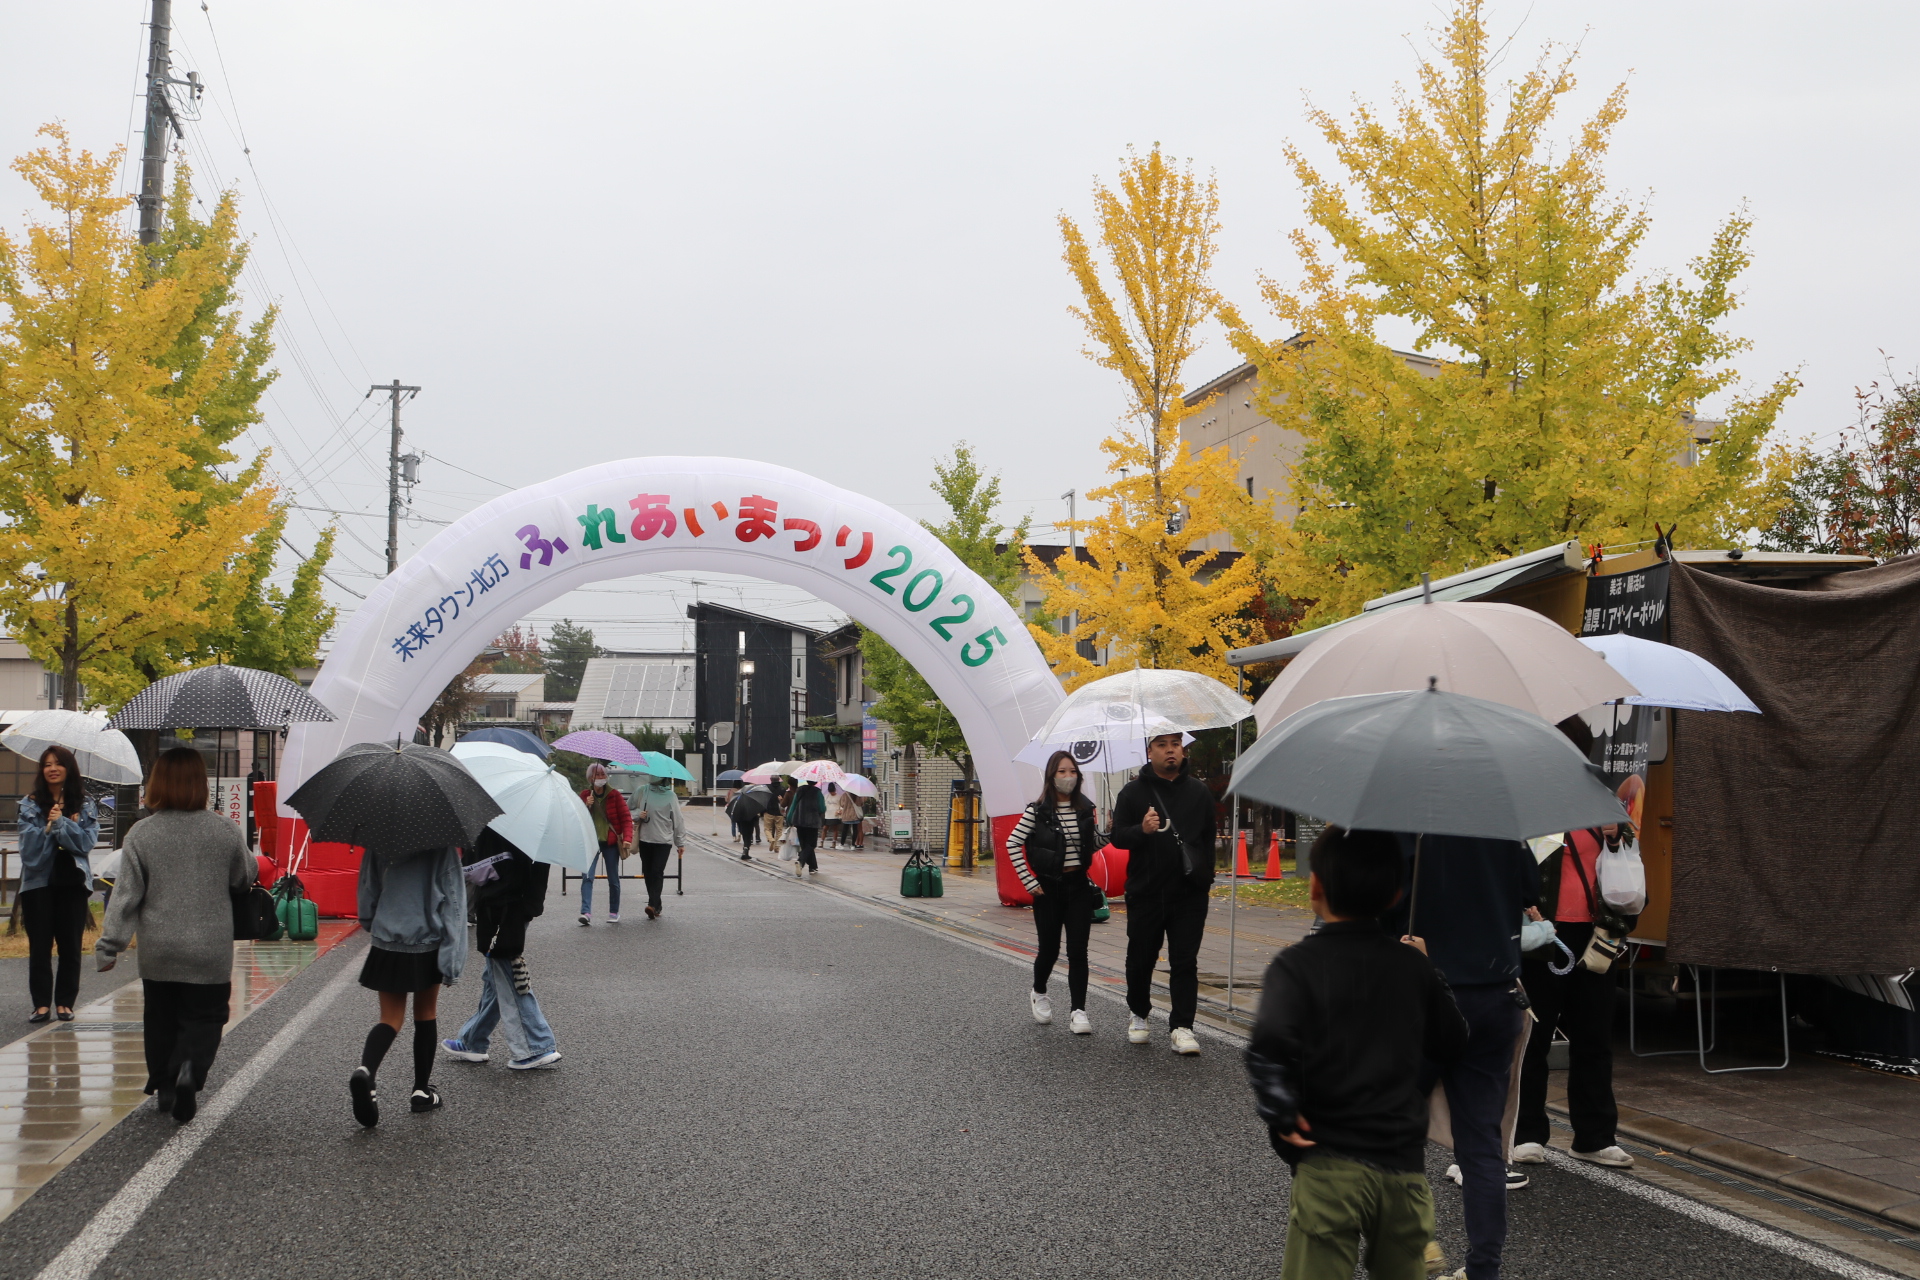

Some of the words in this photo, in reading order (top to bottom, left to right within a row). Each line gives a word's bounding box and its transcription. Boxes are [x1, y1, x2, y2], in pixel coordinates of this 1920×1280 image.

[391, 552, 511, 663] 未来タウン北方
